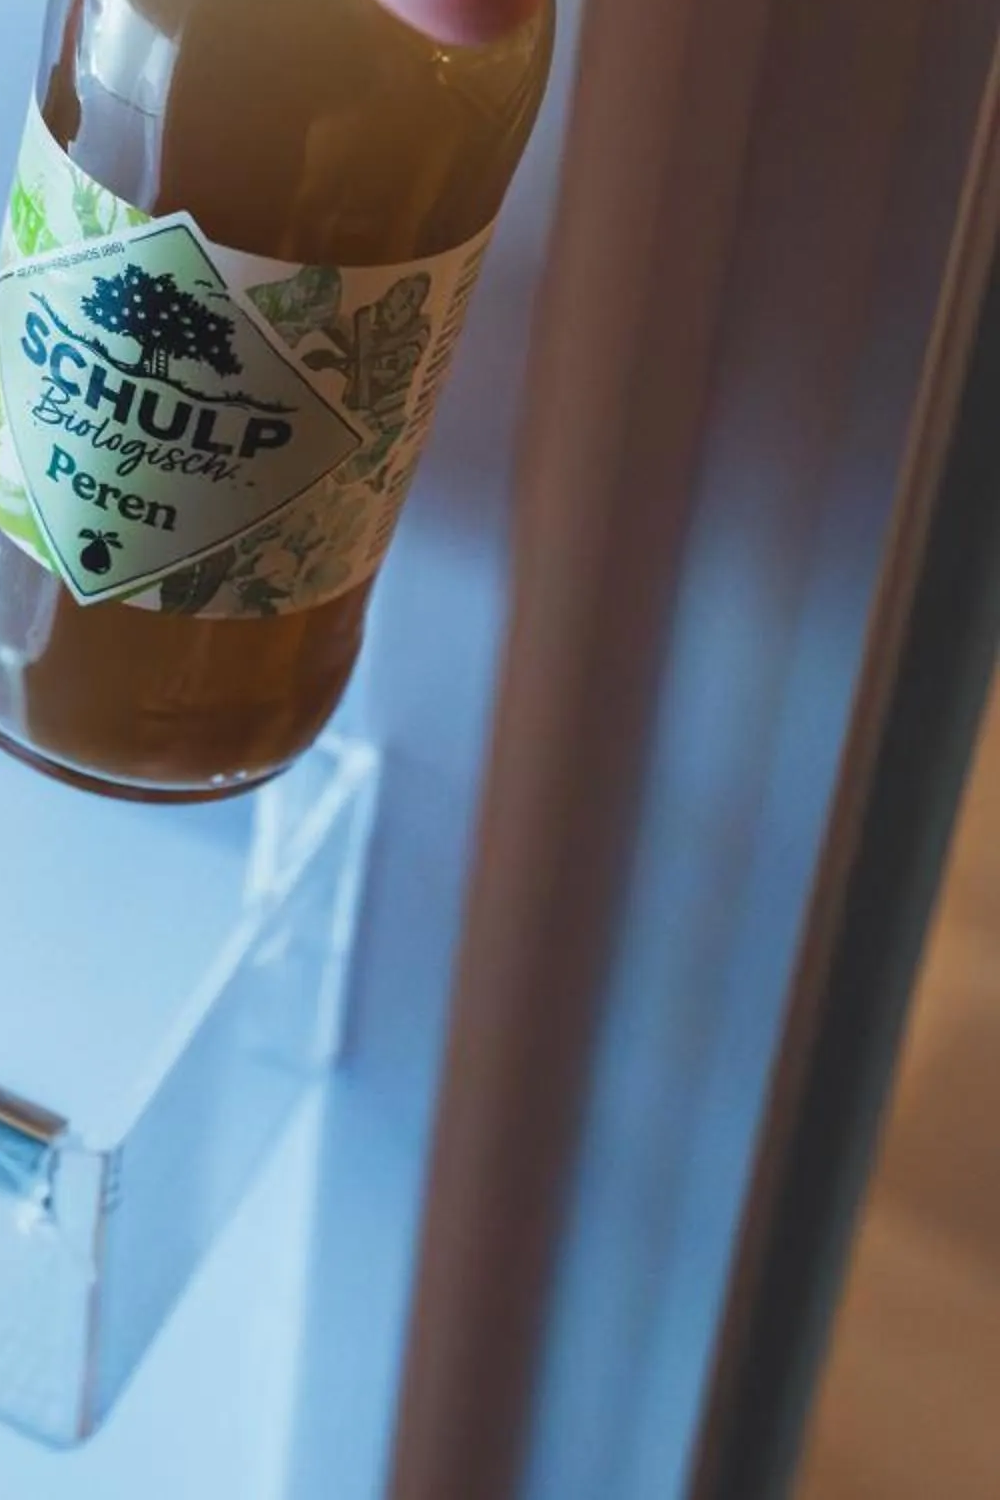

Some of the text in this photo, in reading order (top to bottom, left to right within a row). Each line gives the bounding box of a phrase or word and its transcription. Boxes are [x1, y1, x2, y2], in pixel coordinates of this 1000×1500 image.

[20, 311, 293, 458] SCHULP
[32, 376, 240, 483] Biologisch
[46, 443, 178, 532] Peren
